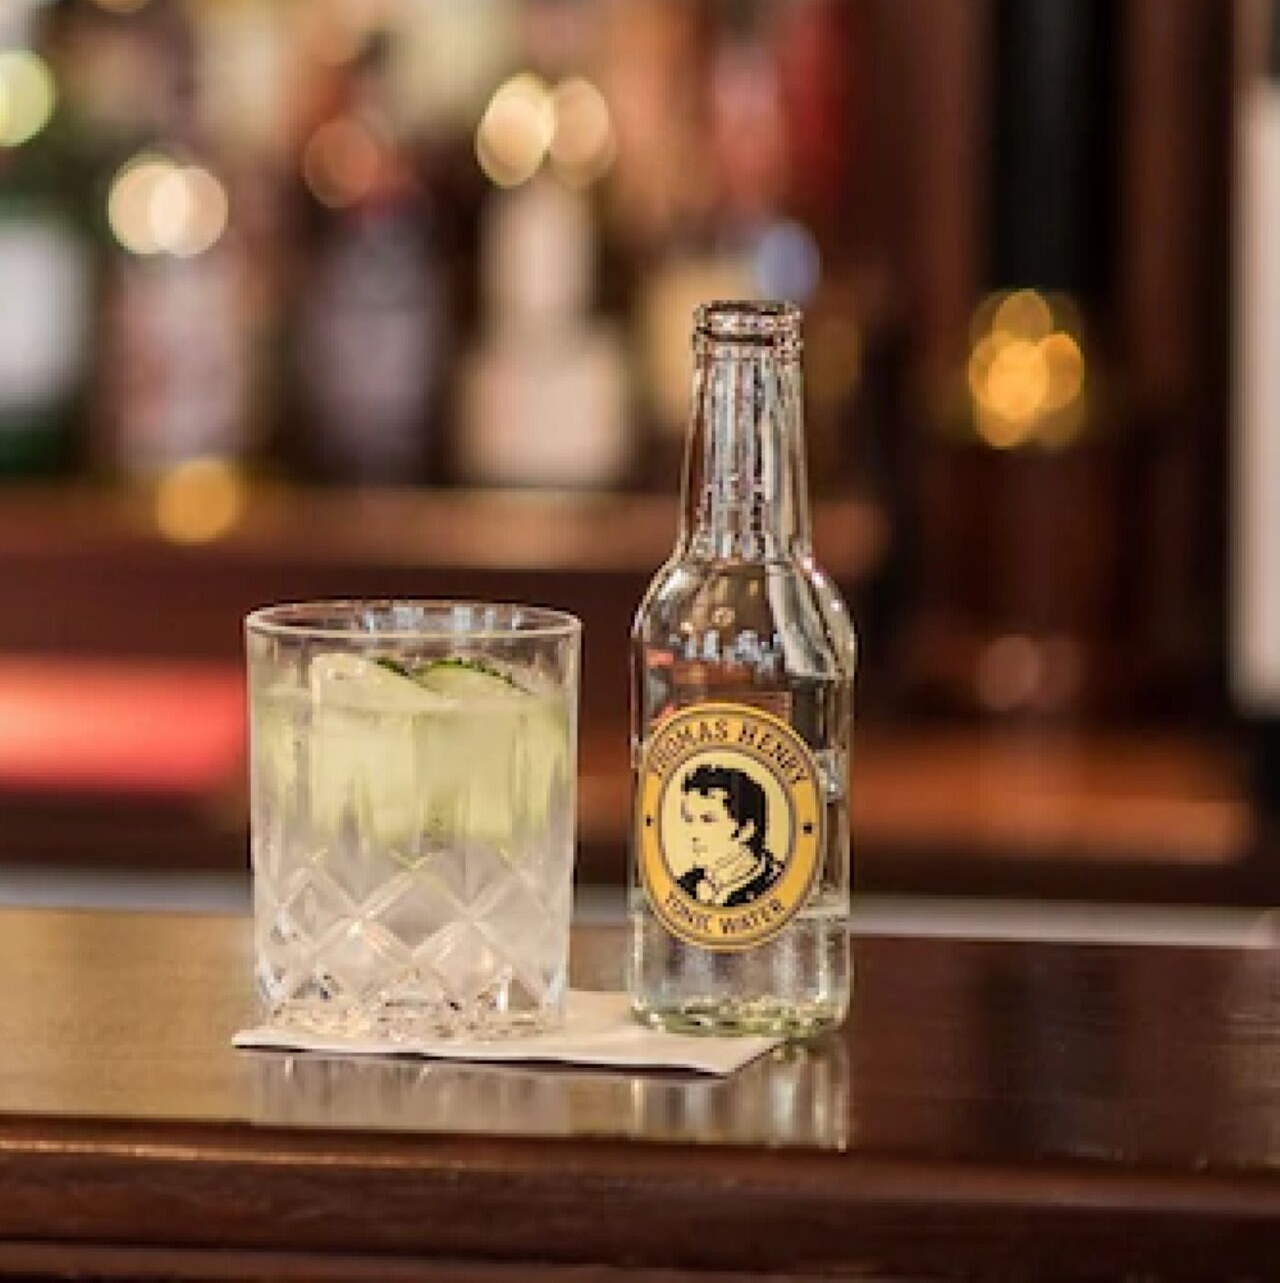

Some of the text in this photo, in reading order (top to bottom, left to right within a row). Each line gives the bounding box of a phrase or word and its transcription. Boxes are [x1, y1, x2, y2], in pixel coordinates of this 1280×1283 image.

[738, 724, 808, 784] HENRY
[665, 891, 785, 934] TONIC WATER
